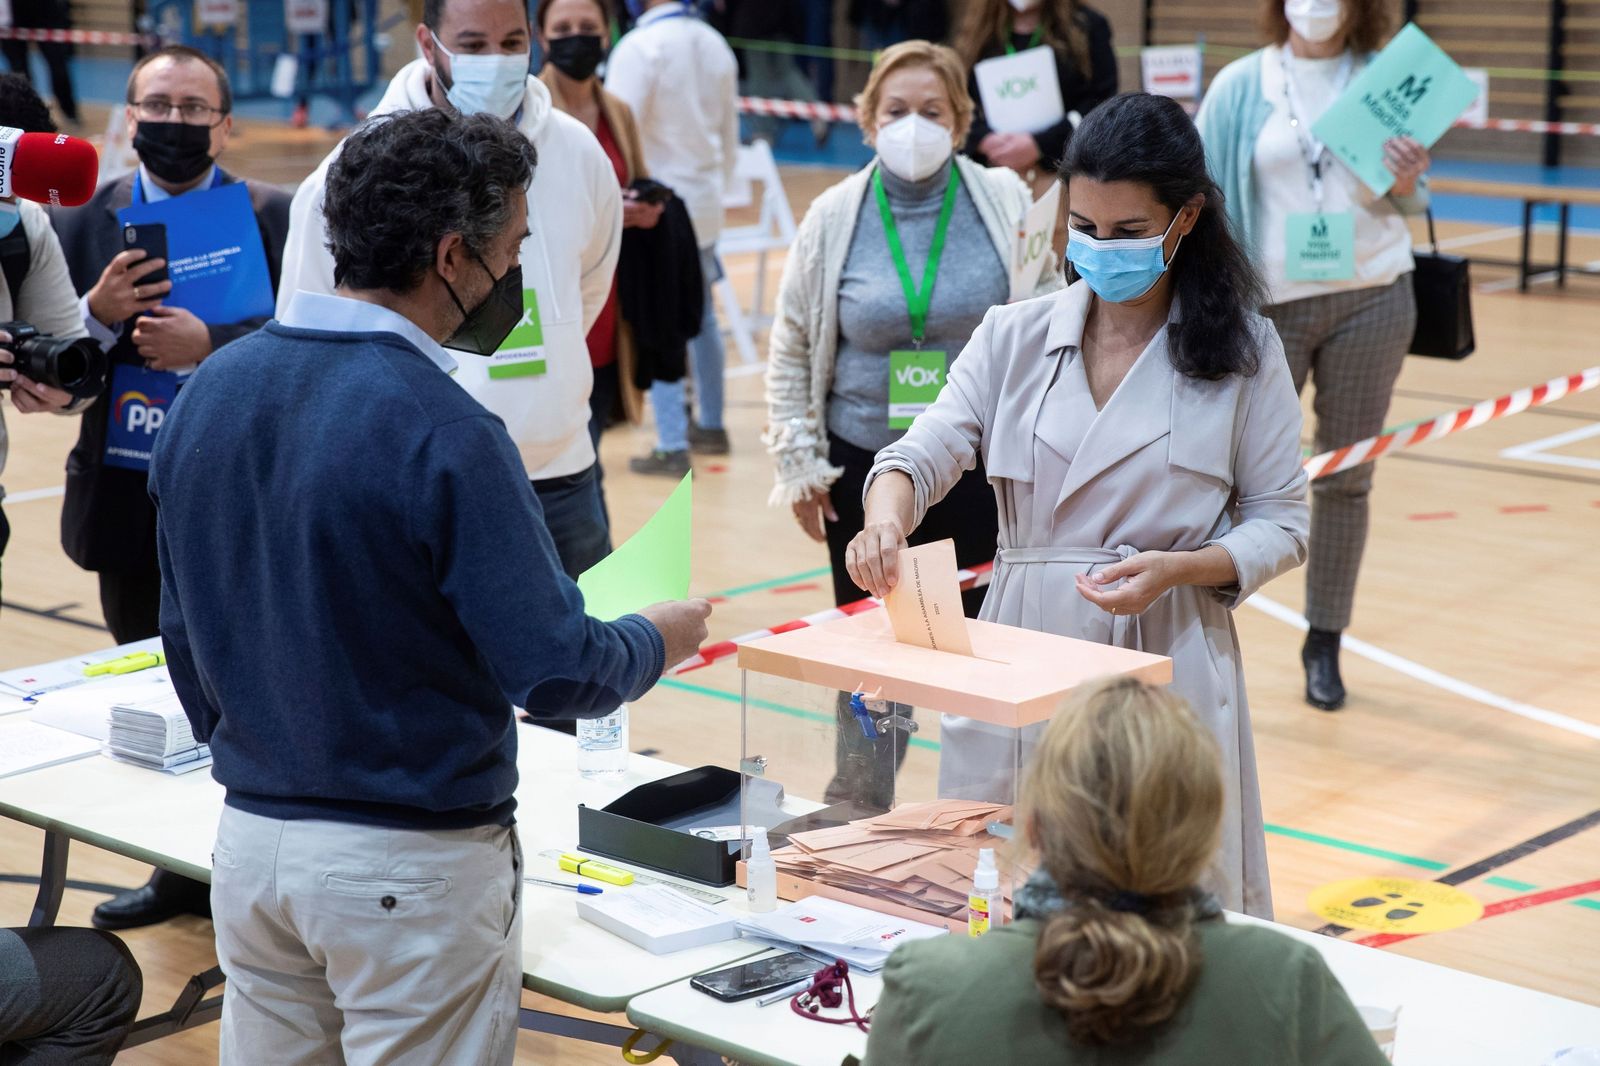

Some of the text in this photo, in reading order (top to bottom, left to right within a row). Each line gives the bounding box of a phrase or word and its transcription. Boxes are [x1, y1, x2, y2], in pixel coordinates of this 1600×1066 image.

[994, 73, 1039, 100] VOX
[895, 364, 940, 387] VOX
[917, 588, 928, 618] ASAMBLEA
